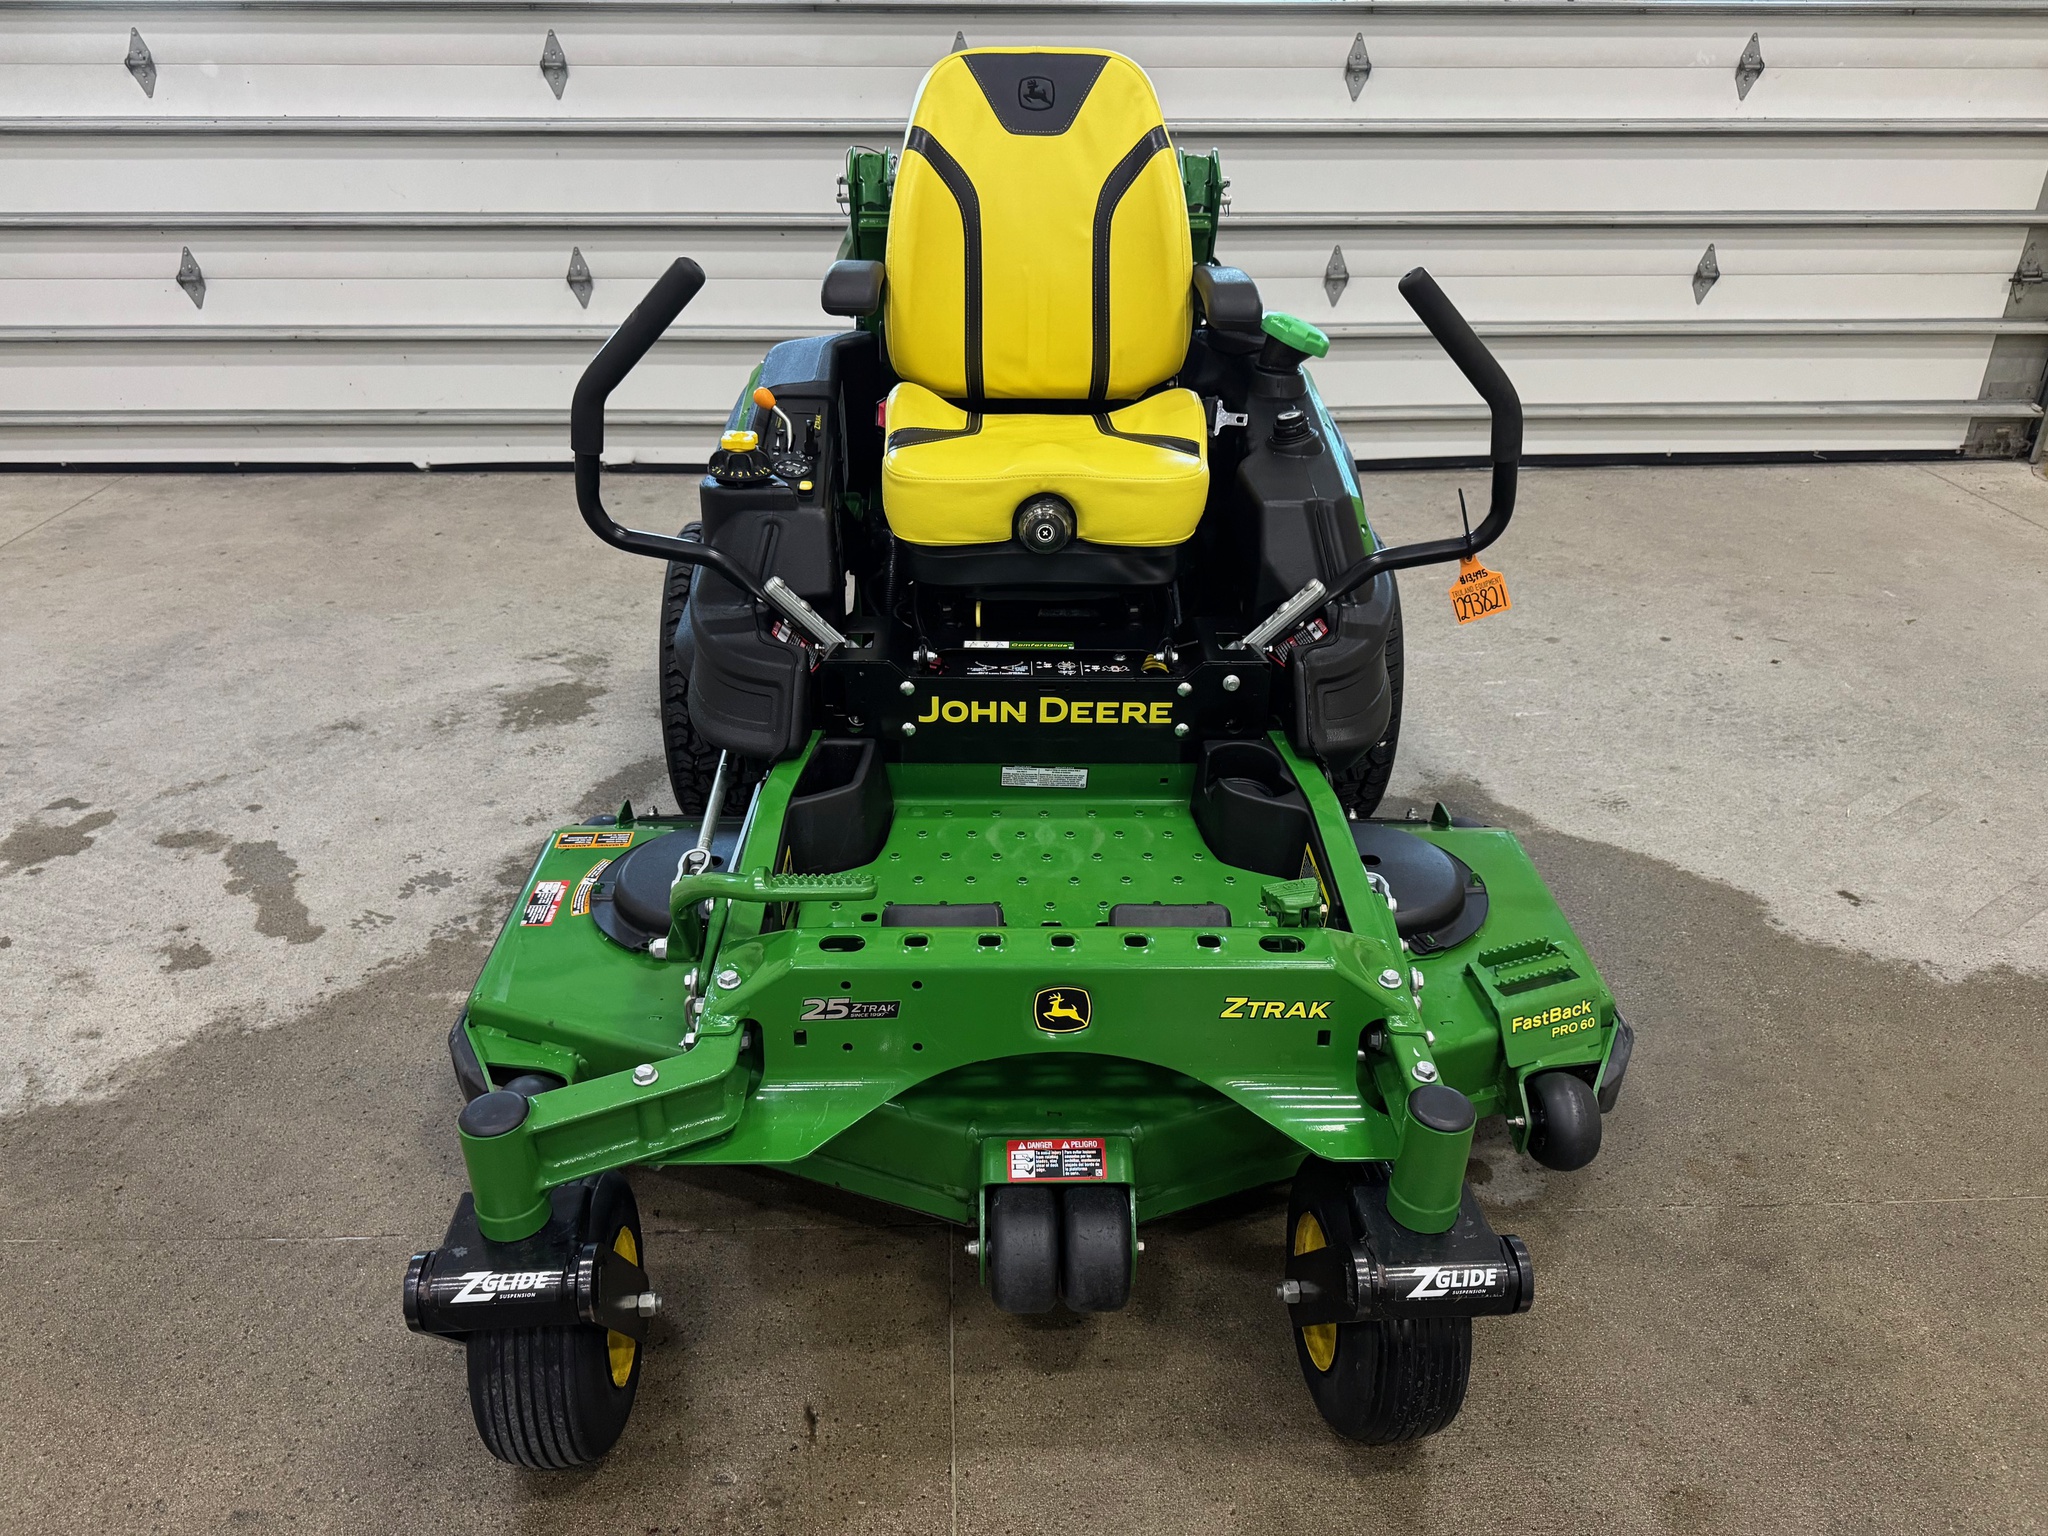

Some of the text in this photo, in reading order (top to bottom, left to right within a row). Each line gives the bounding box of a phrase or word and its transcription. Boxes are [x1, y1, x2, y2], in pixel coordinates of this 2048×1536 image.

[1451, 575, 1502, 599] TRULAND EQUIPMENT
[1452, 584, 1507, 622] 1293821
[918, 696, 1174, 724] JOHN DEERE
[800, 998, 896, 1020] 25 ZTRAK
[1220, 997, 1332, 1018] ZTRAK
[1512, 1000, 1592, 1033] FastBack
[1551, 1017, 1595, 1038] PRO 60
[1027, 1141, 1053, 1149] DANGER
[1071, 1140, 1098, 1148] PELIGRO
[450, 1271, 551, 1304] ZGLIDE
[1405, 1266, 1498, 1298] ZGLIDE
